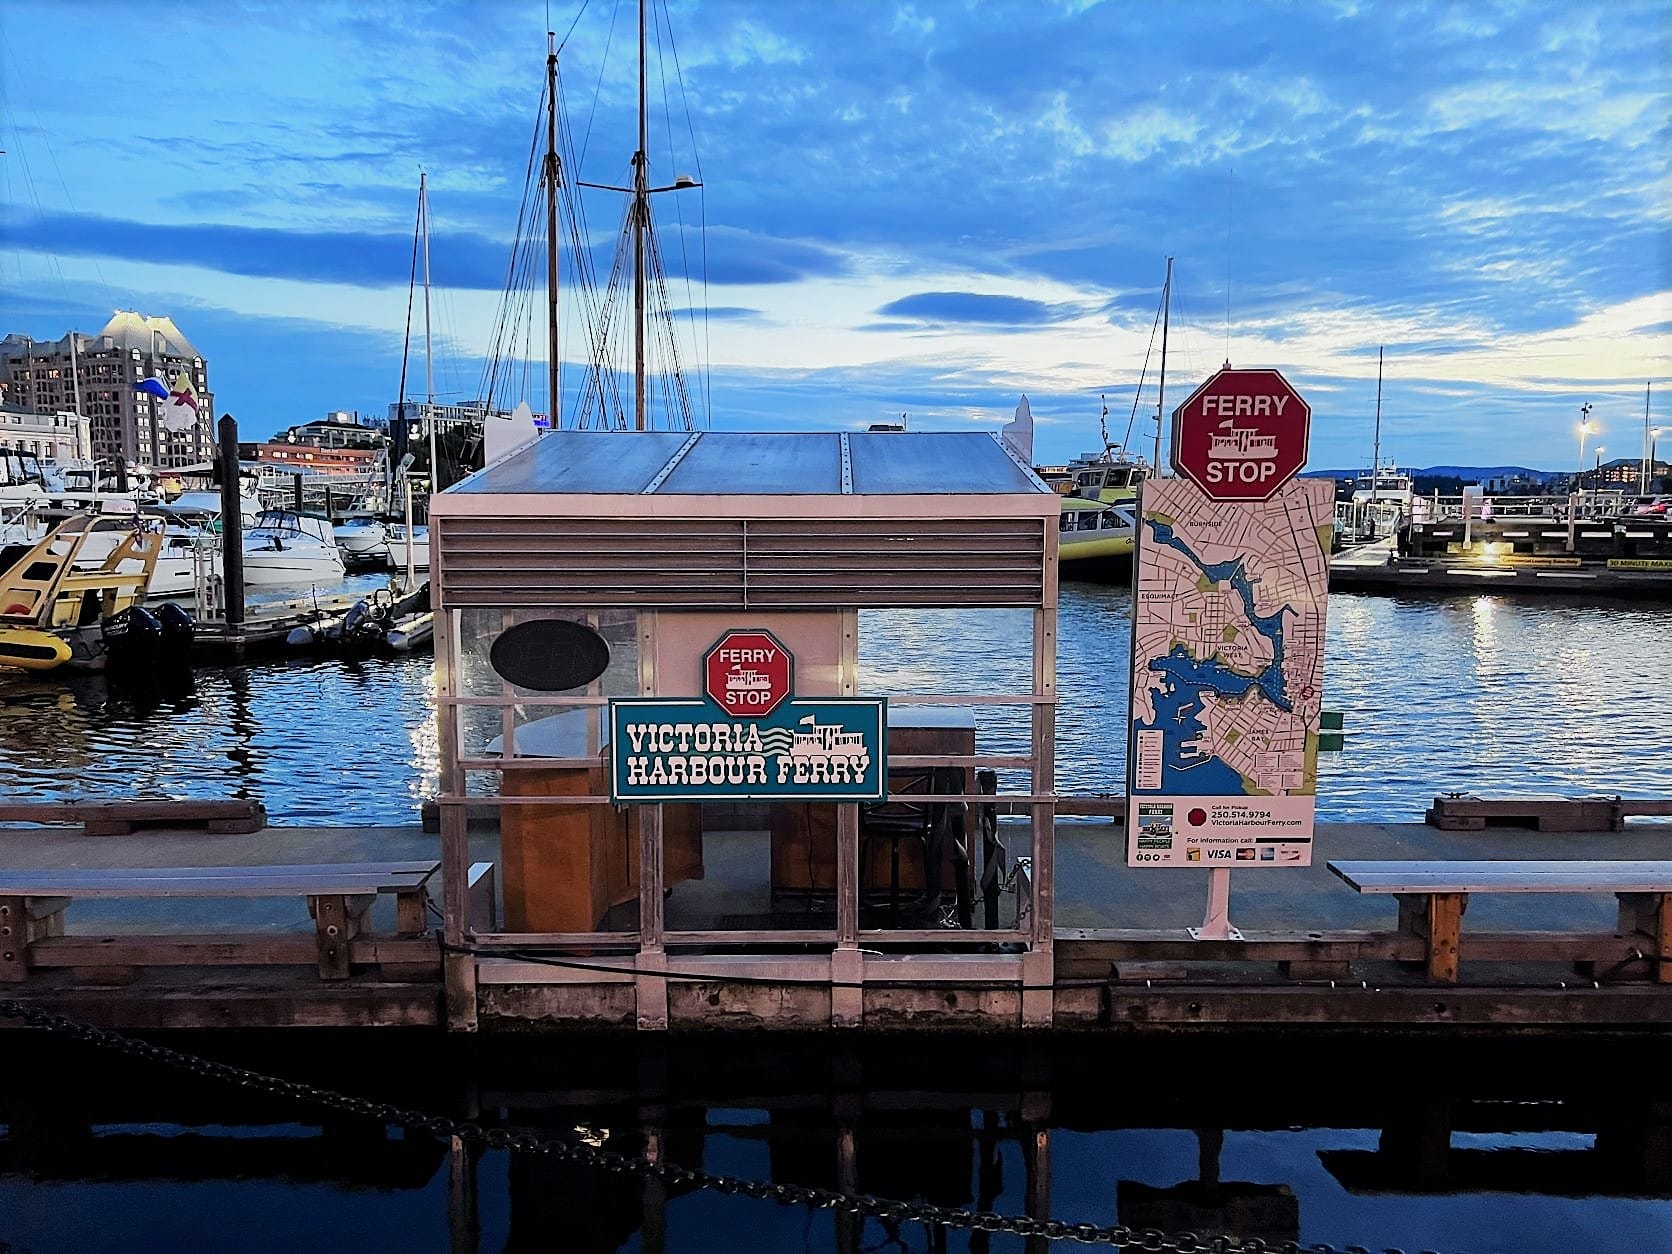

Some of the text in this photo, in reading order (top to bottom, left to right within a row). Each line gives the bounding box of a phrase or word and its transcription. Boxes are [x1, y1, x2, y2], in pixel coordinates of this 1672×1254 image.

[1202, 395, 1289, 416] FERRY
[1206, 461, 1276, 483] STOP
[719, 648, 776, 663] FERRY
[725, 690, 772, 705] STOP
[626, 723, 763, 753] VICTORIA
[627, 755, 870, 786] HARBOUR FERRY
[1211, 811, 1271, 819] 250.514.9794
[1211, 819, 1302, 827] VictoriaHarbourFerry.com
[1207, 849, 1232, 859] VISA
